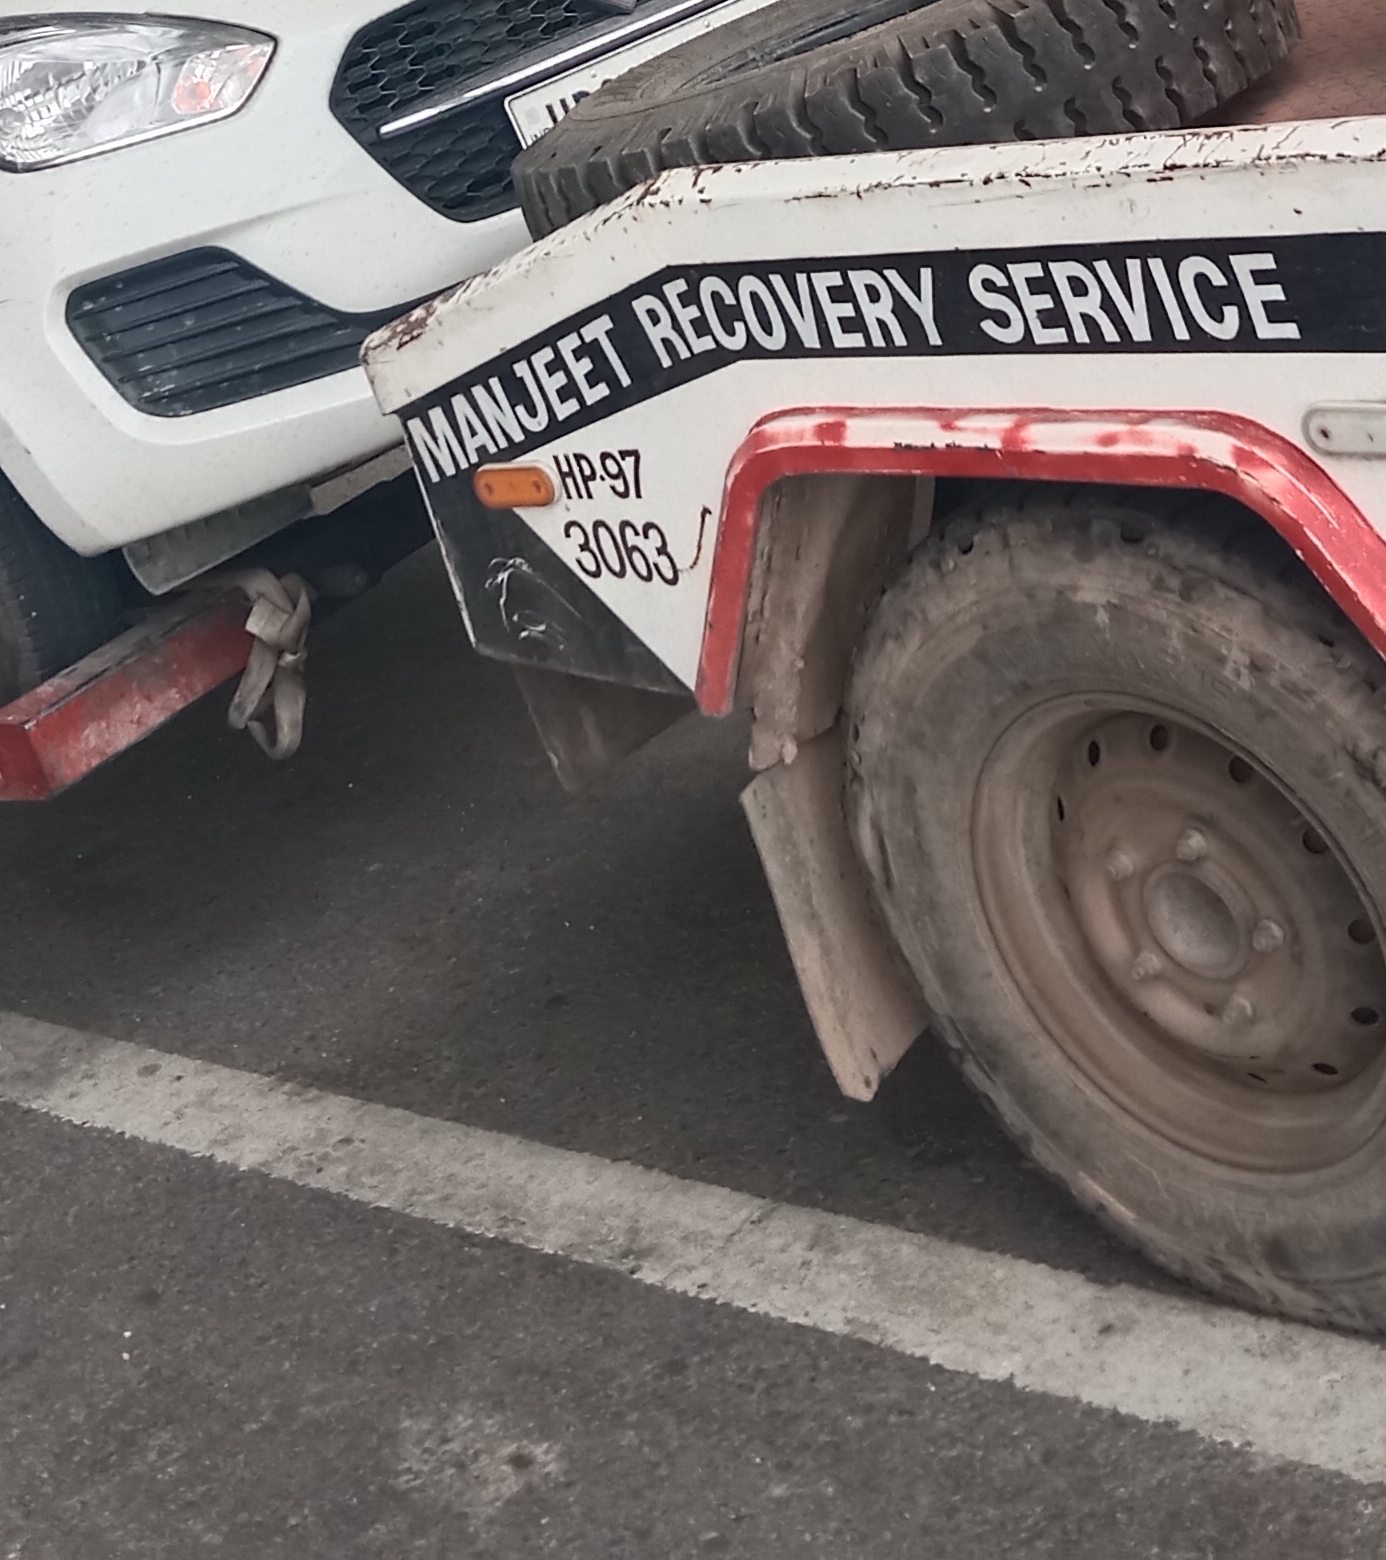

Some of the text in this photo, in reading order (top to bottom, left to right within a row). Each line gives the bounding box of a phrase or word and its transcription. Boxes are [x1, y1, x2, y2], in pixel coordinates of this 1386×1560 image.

[406, 251, 1303, 483] MANJEET RECOVERY SERVICE
[563, 519, 680, 586] 3063
